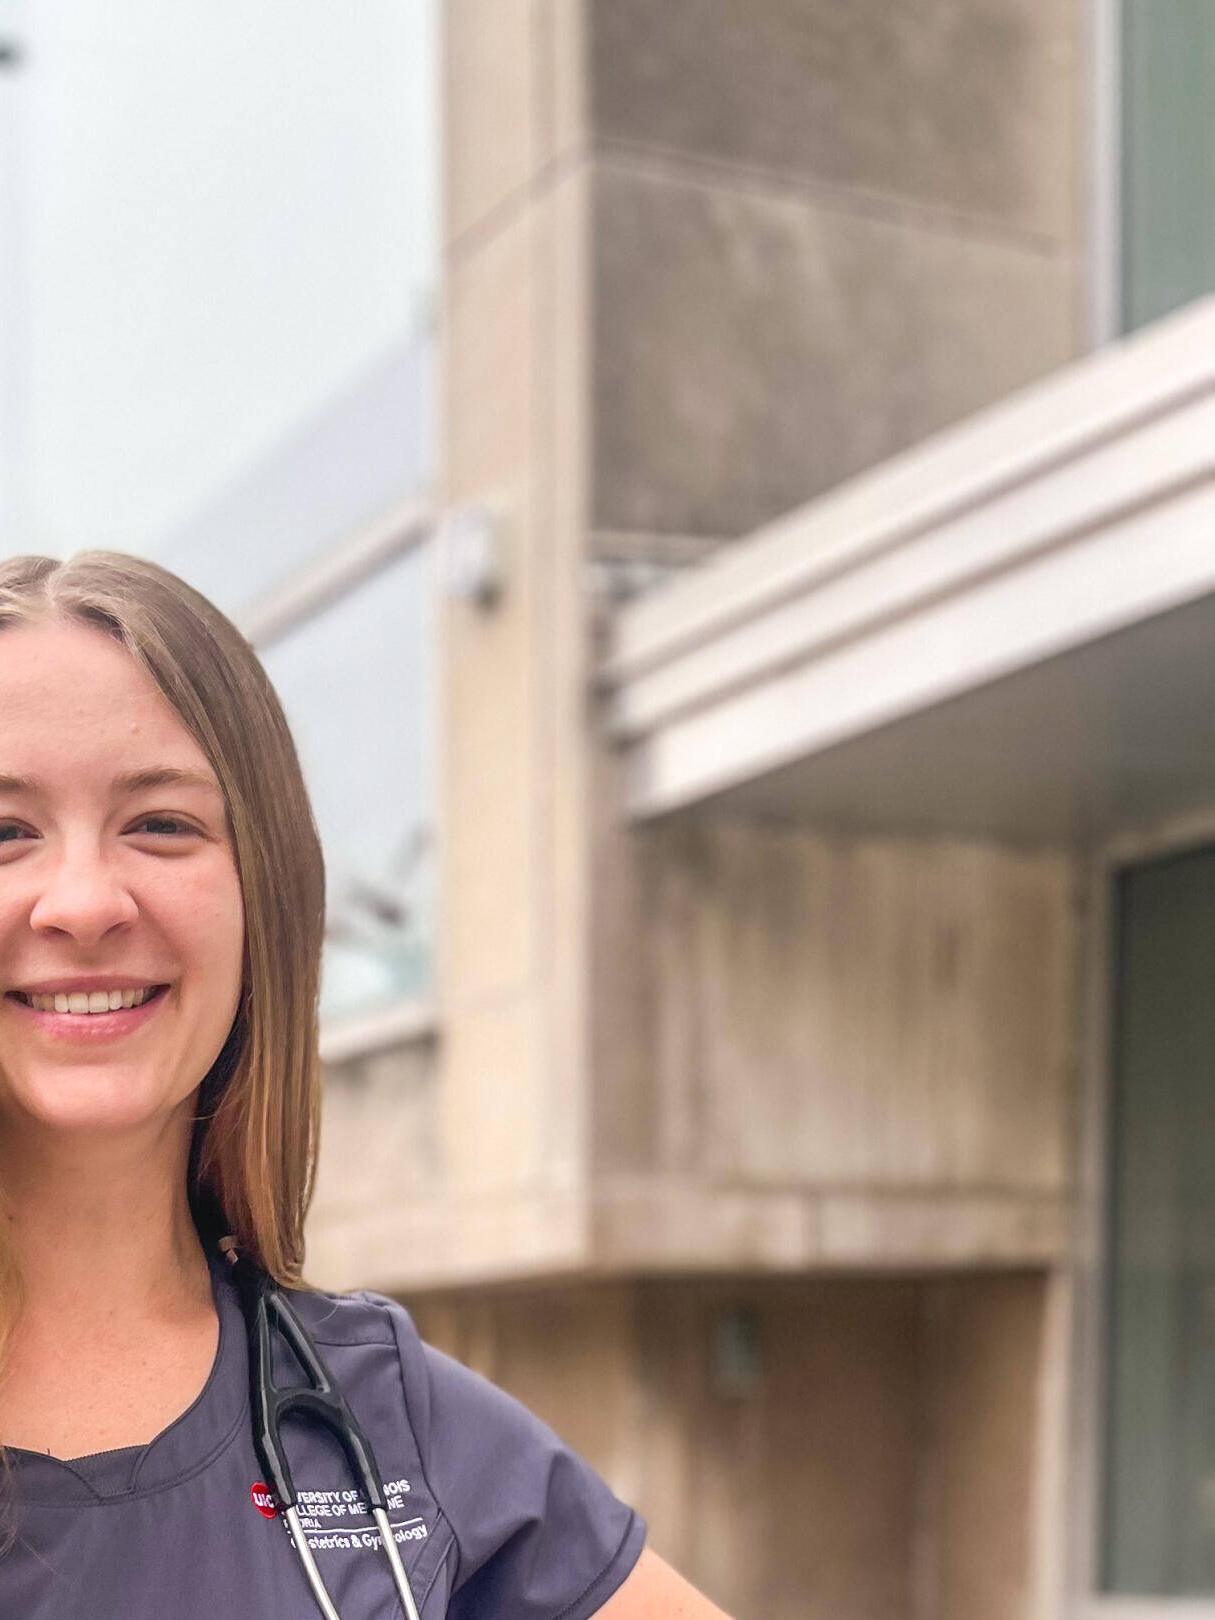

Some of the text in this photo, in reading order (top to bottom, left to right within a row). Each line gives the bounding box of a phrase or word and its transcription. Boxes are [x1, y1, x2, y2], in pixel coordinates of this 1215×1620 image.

[253, 1492, 275, 1509] UIC
[342, 1490, 358, 1502] OF
[296, 1504, 333, 1517] LLEGE
[333, 1503, 348, 1517] OF
[291, 1531, 351, 1550] stetrics
[351, 1534, 362, 1549] &
